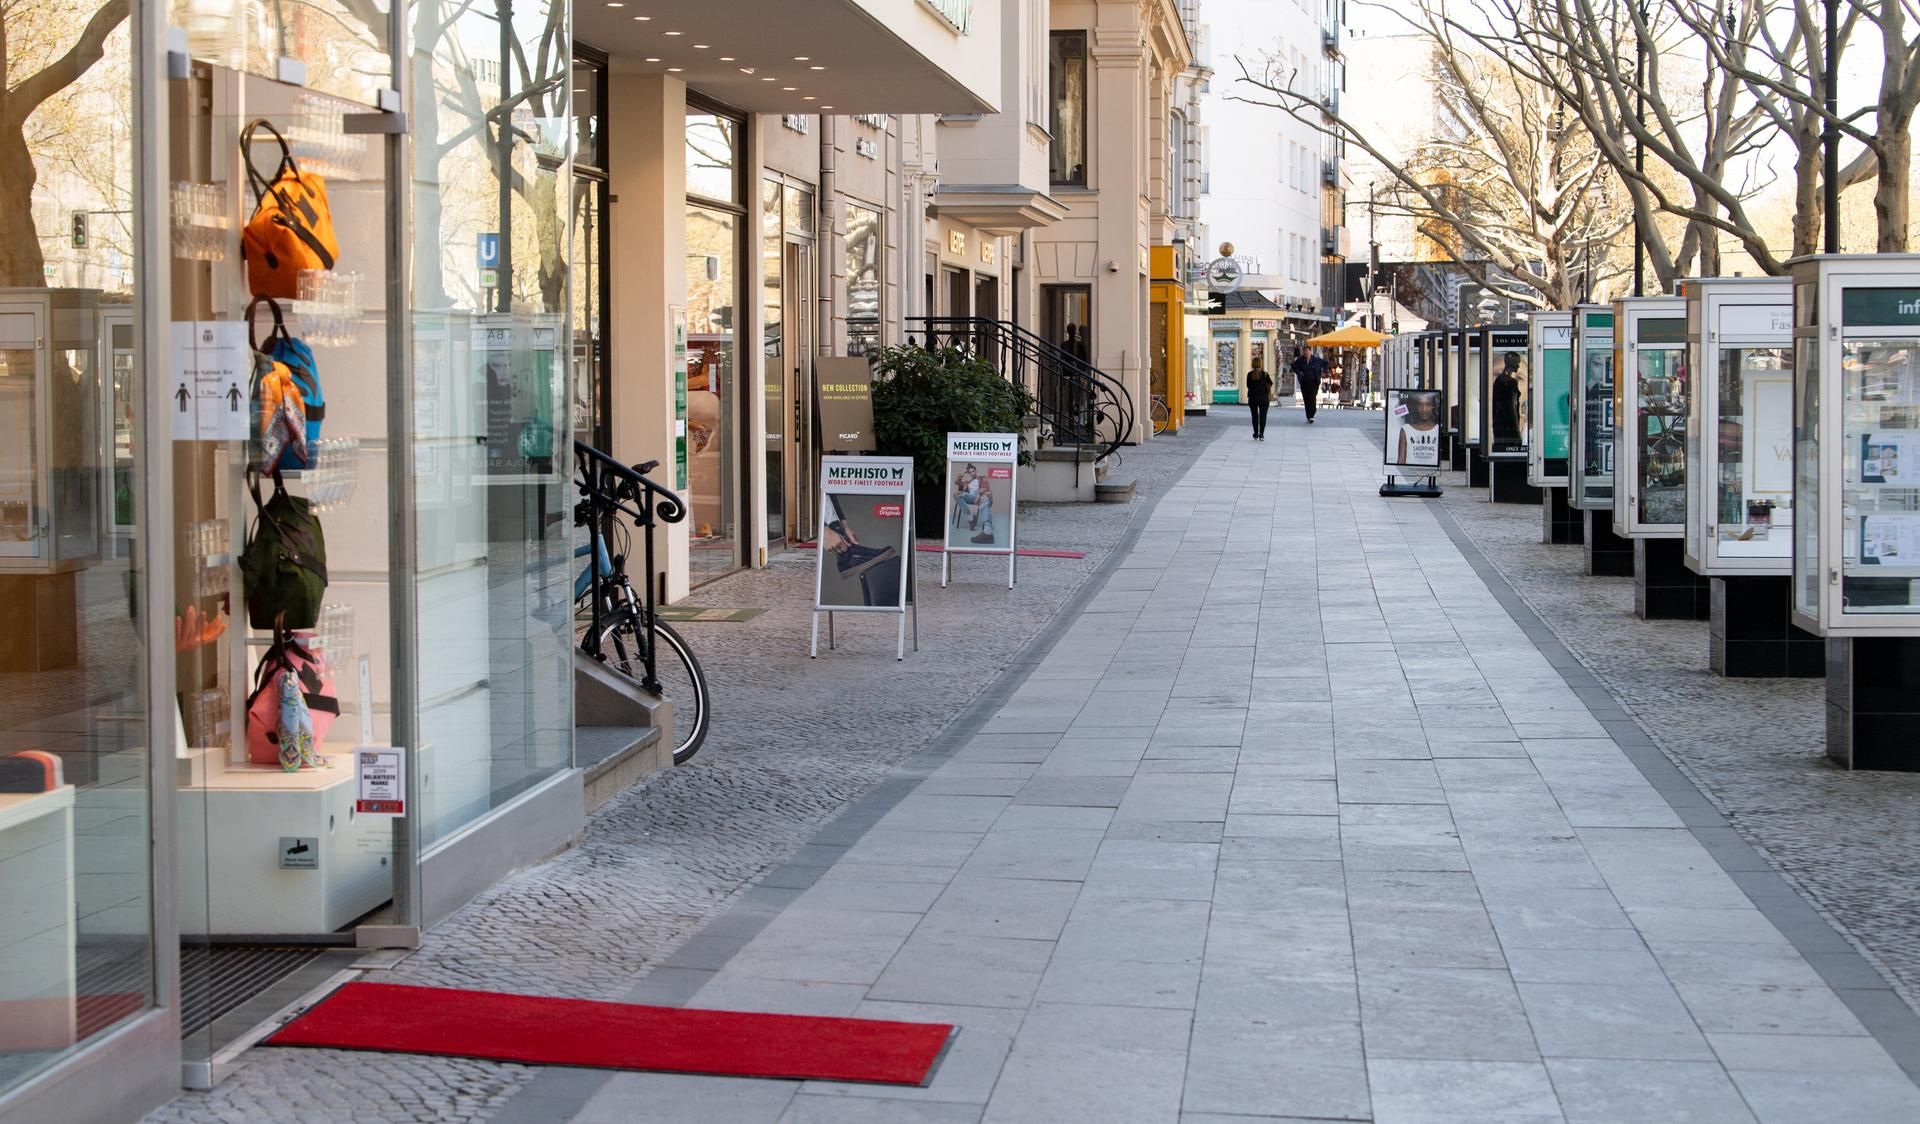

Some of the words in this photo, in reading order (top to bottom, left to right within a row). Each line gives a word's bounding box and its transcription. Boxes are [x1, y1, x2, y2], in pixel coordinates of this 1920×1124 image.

[822, 384, 834, 392] NEW
[836, 384, 868, 392] COLLECTION
[953, 442, 1000, 451] MEPHISTO
[829, 467, 888, 479] MEPHISTO
